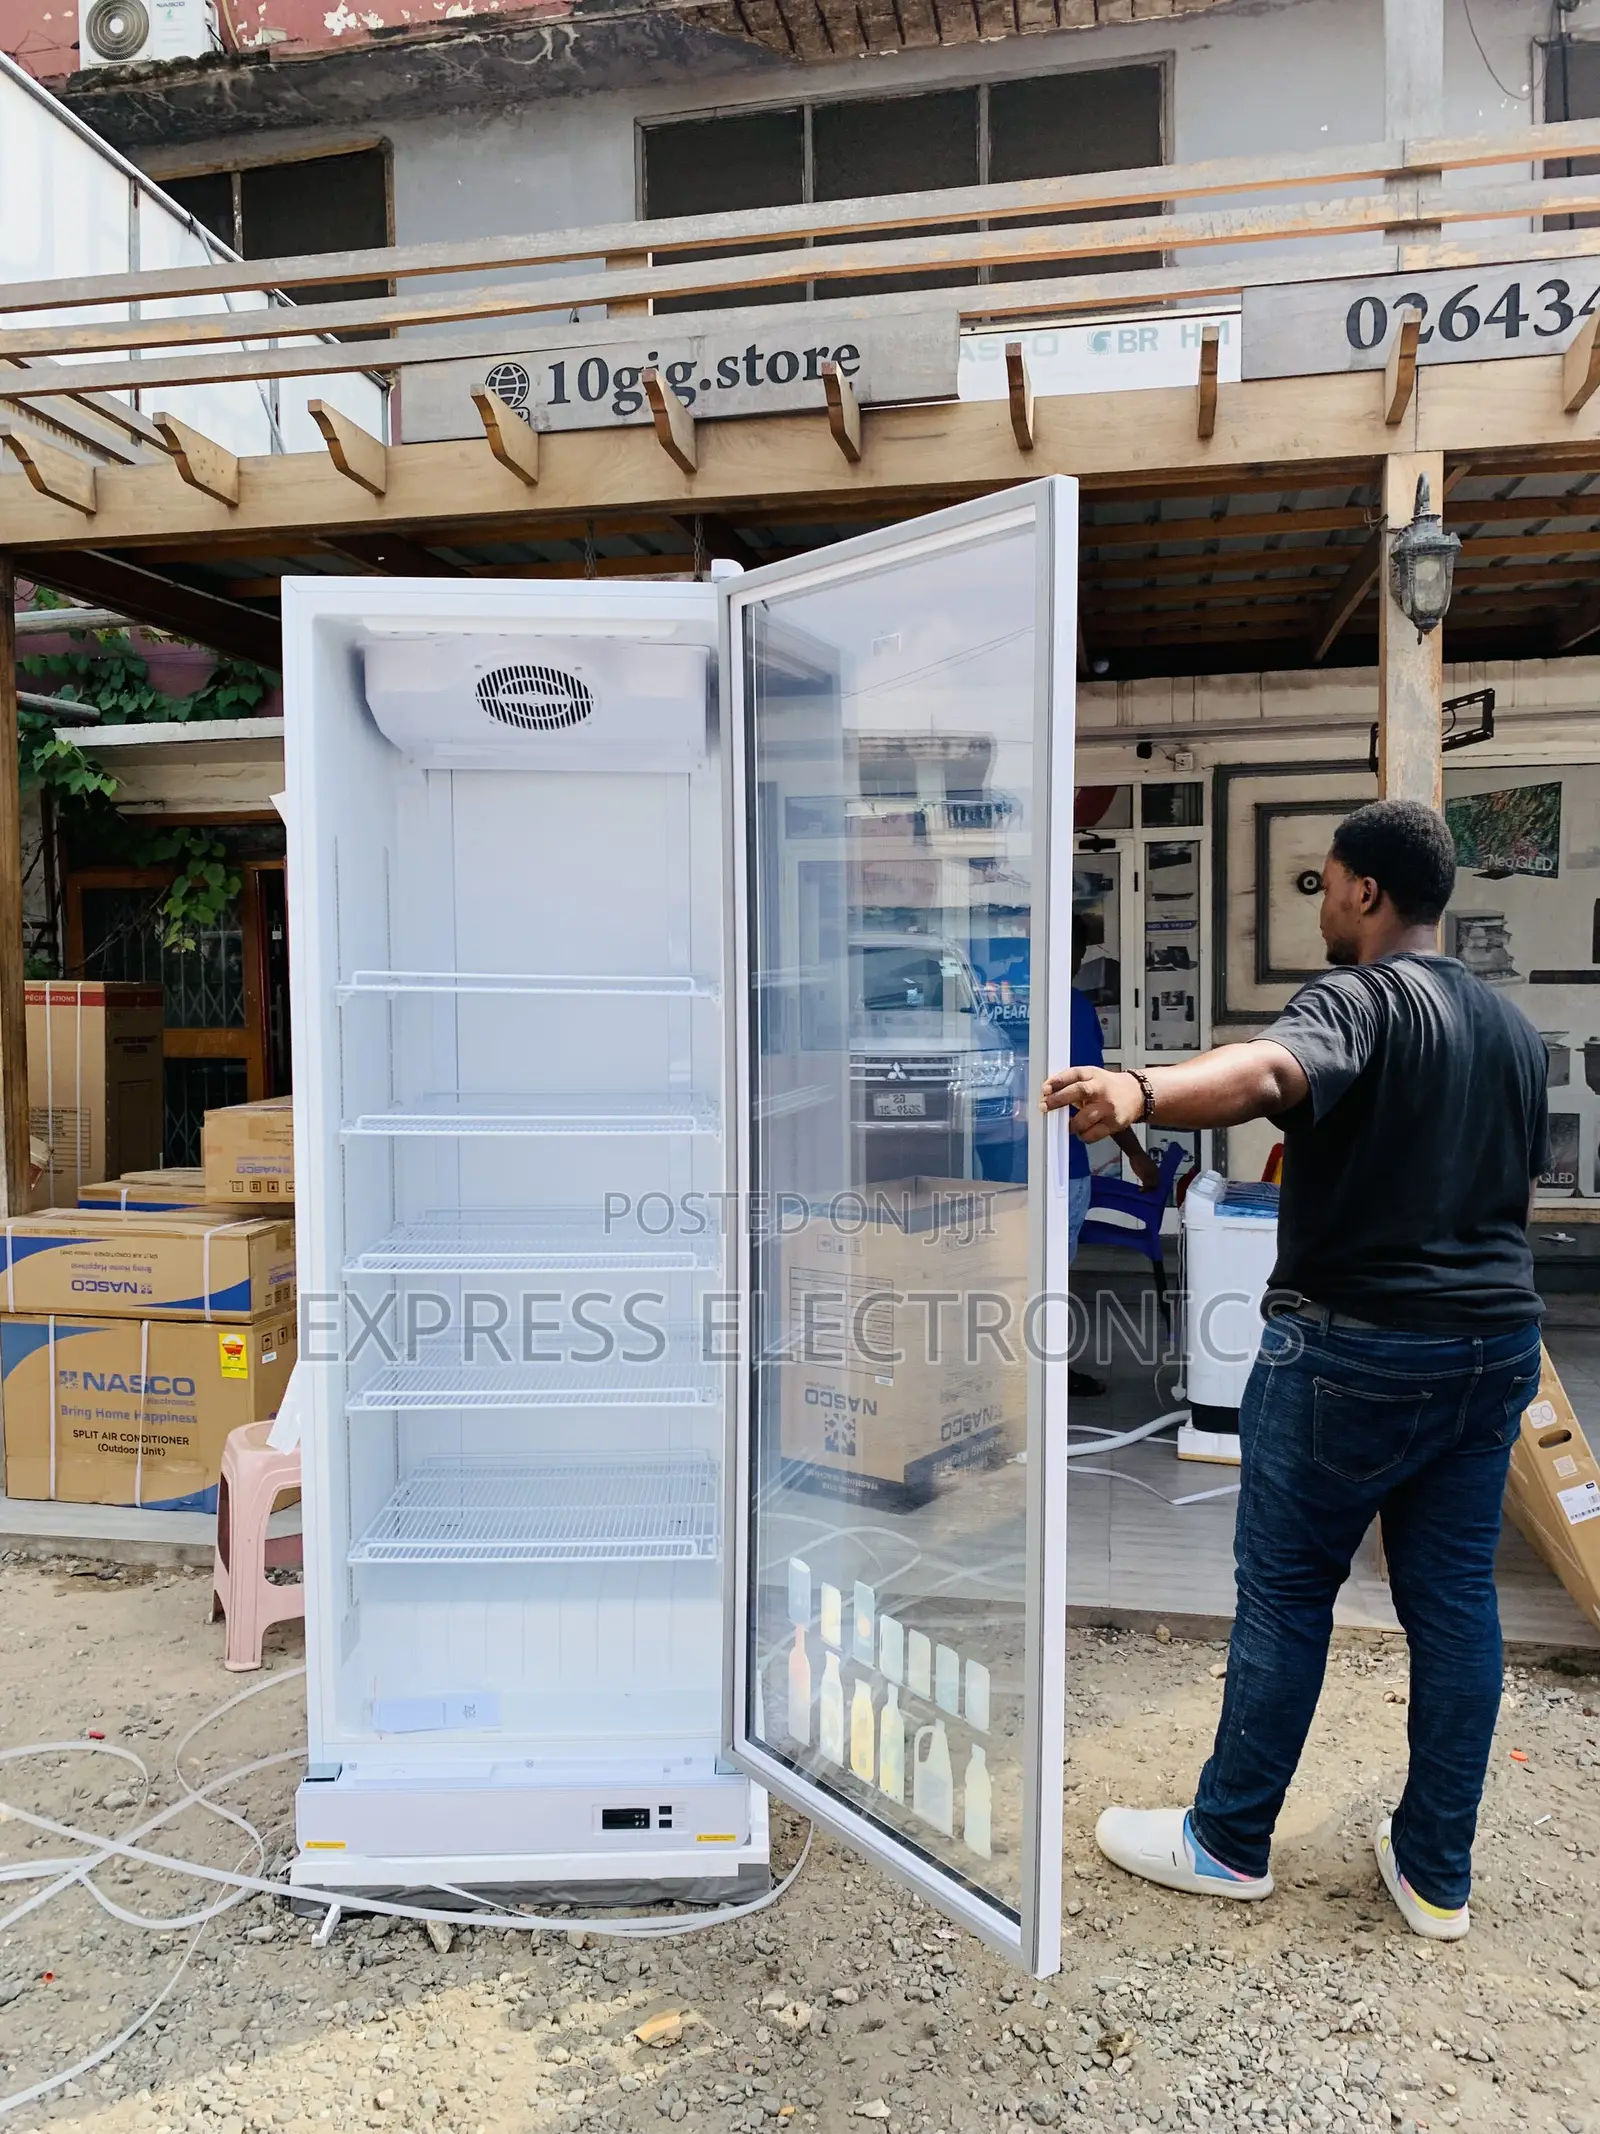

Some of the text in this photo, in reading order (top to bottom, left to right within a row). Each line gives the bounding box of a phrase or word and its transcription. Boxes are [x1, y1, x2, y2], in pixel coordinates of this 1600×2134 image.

[1516, 855, 1553, 871] QLED
[1539, 1172, 1575, 1185] QLED
[71, 1280, 138, 1294] NASCO
[83, 1371, 196, 1396] NASCO
[804, 1389, 878, 1416] NASCO
[61, 1404, 197, 1425] Bring Home Happiness
[73, 1429, 190, 1446] SPLIT AIR CONDITIONER
[97, 1443, 166, 1457] (Outdoor Unit)
